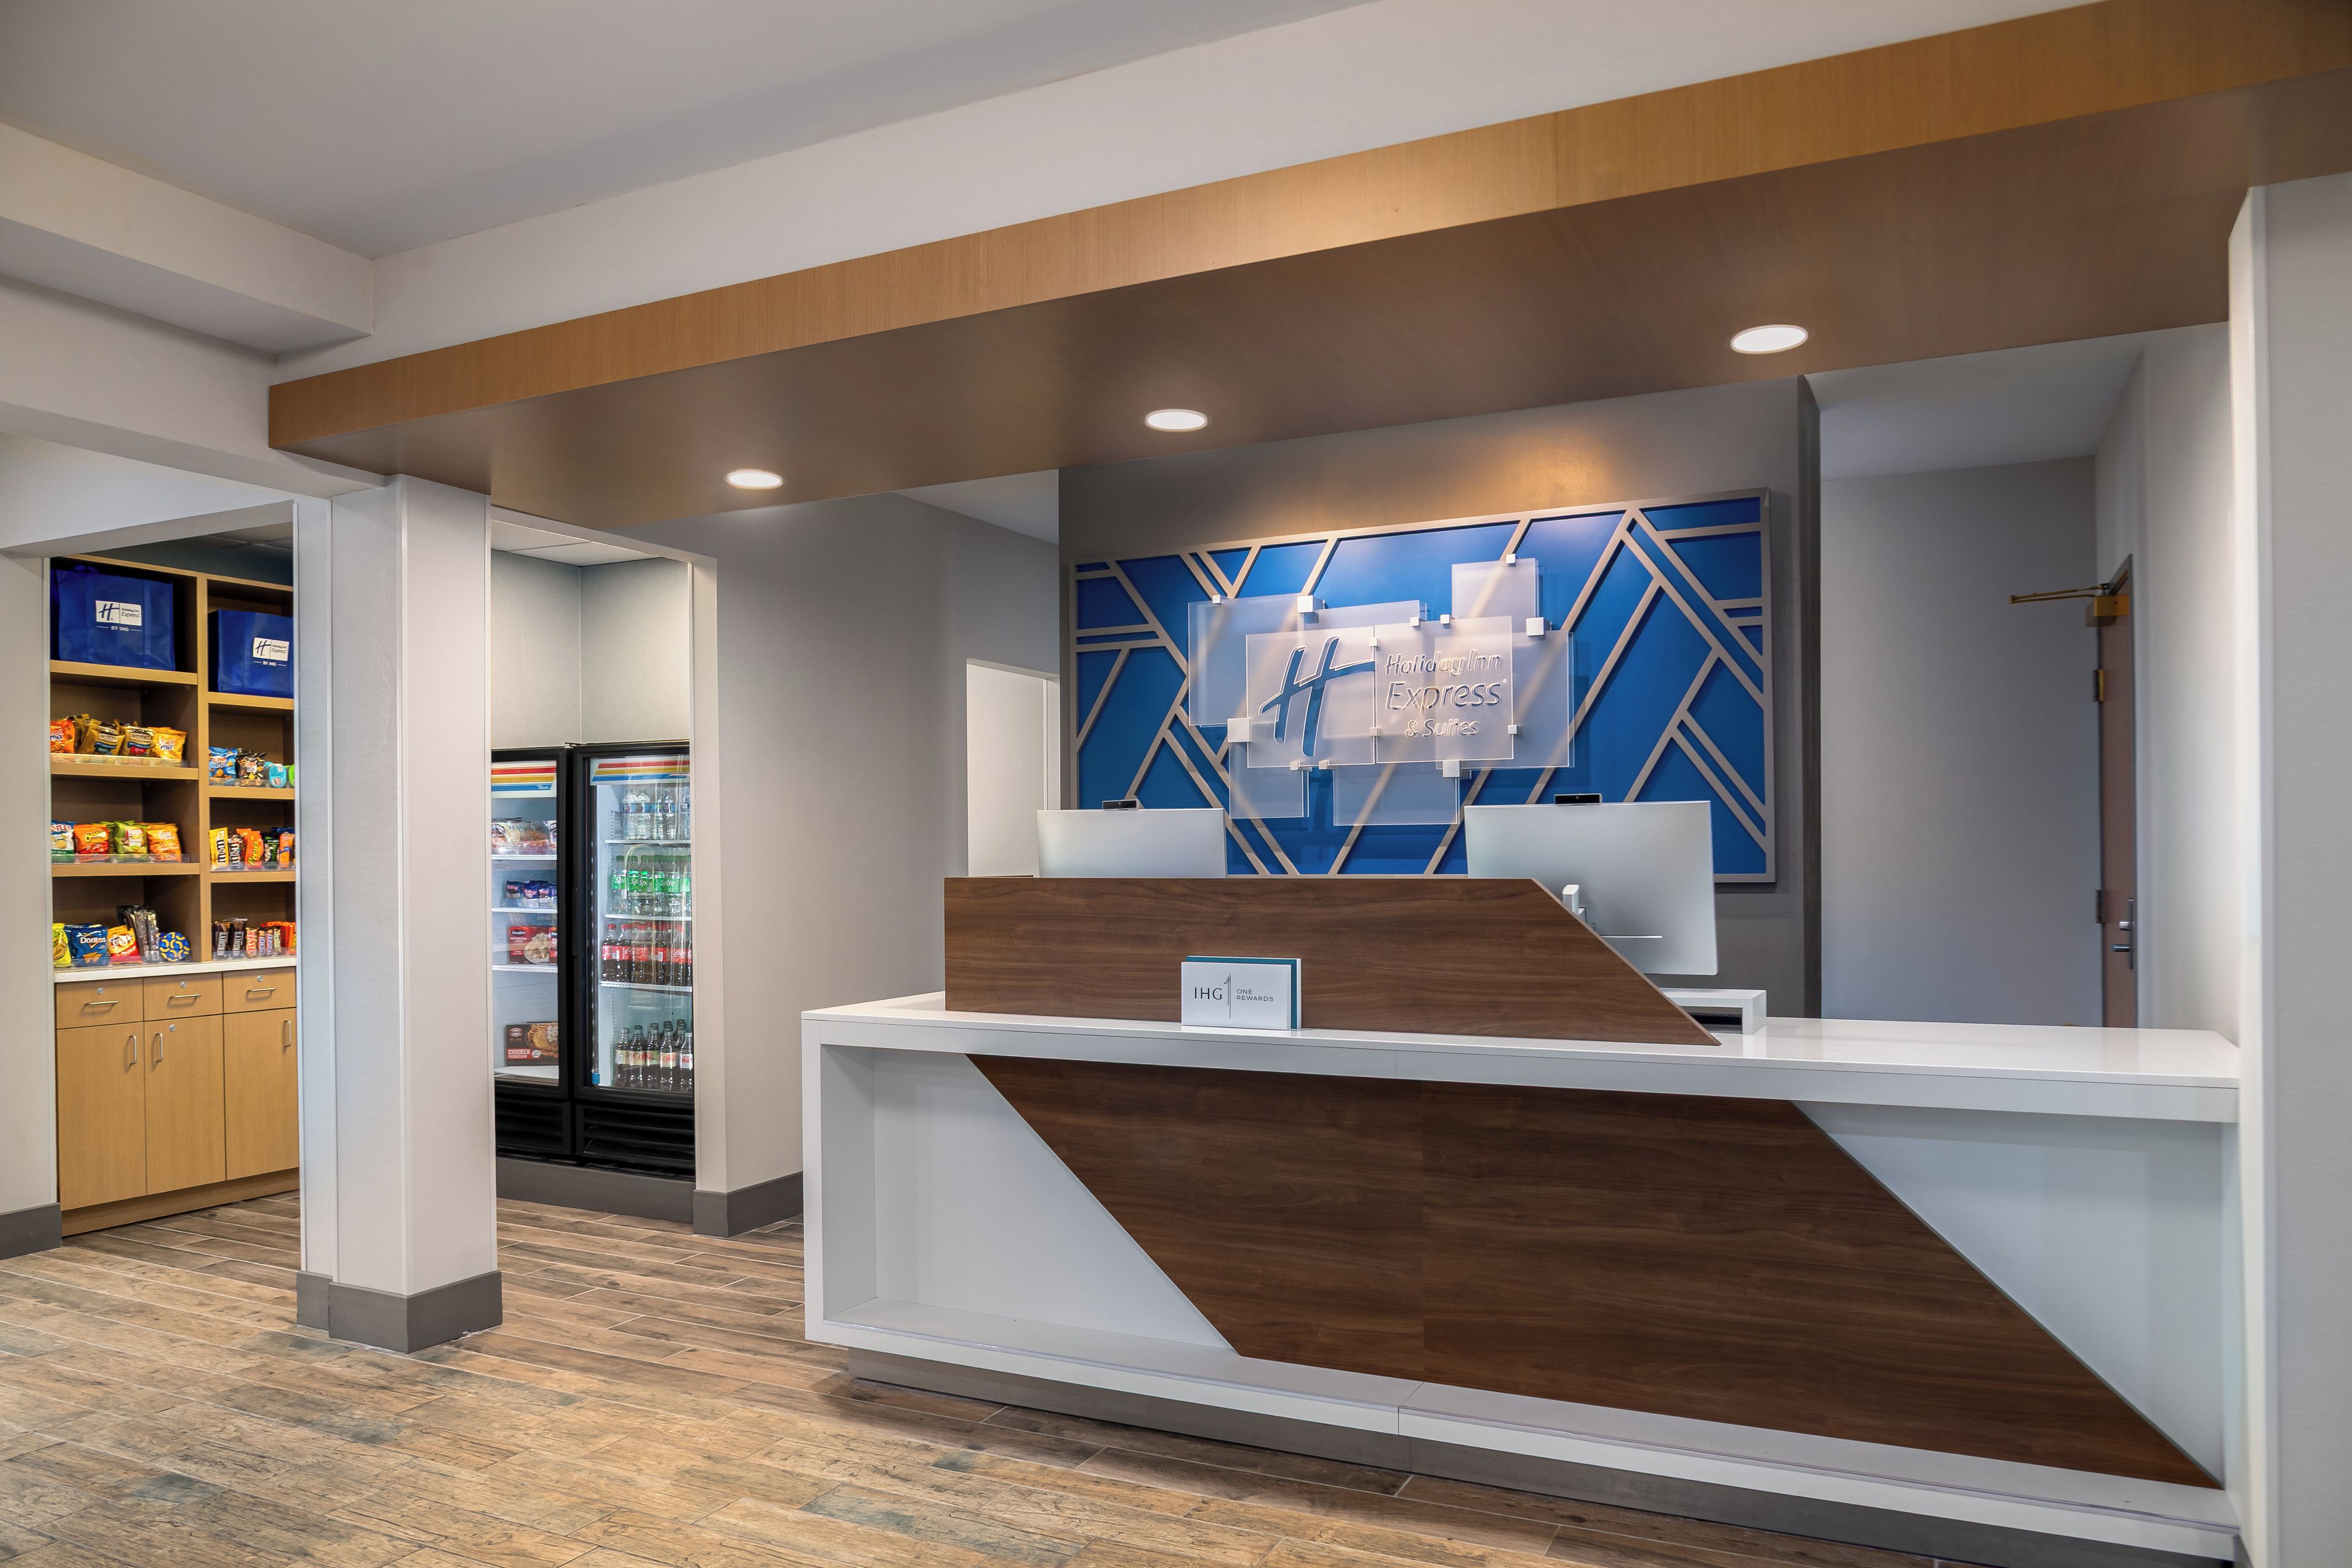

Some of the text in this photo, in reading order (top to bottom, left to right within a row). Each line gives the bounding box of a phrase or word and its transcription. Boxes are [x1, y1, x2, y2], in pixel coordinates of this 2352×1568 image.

[1384, 649, 1501, 677] Holiday Inn
[1386, 680, 1502, 717] Express
[1405, 718, 1480, 737] & Suites
[1194, 987, 1222, 1000] IHG
